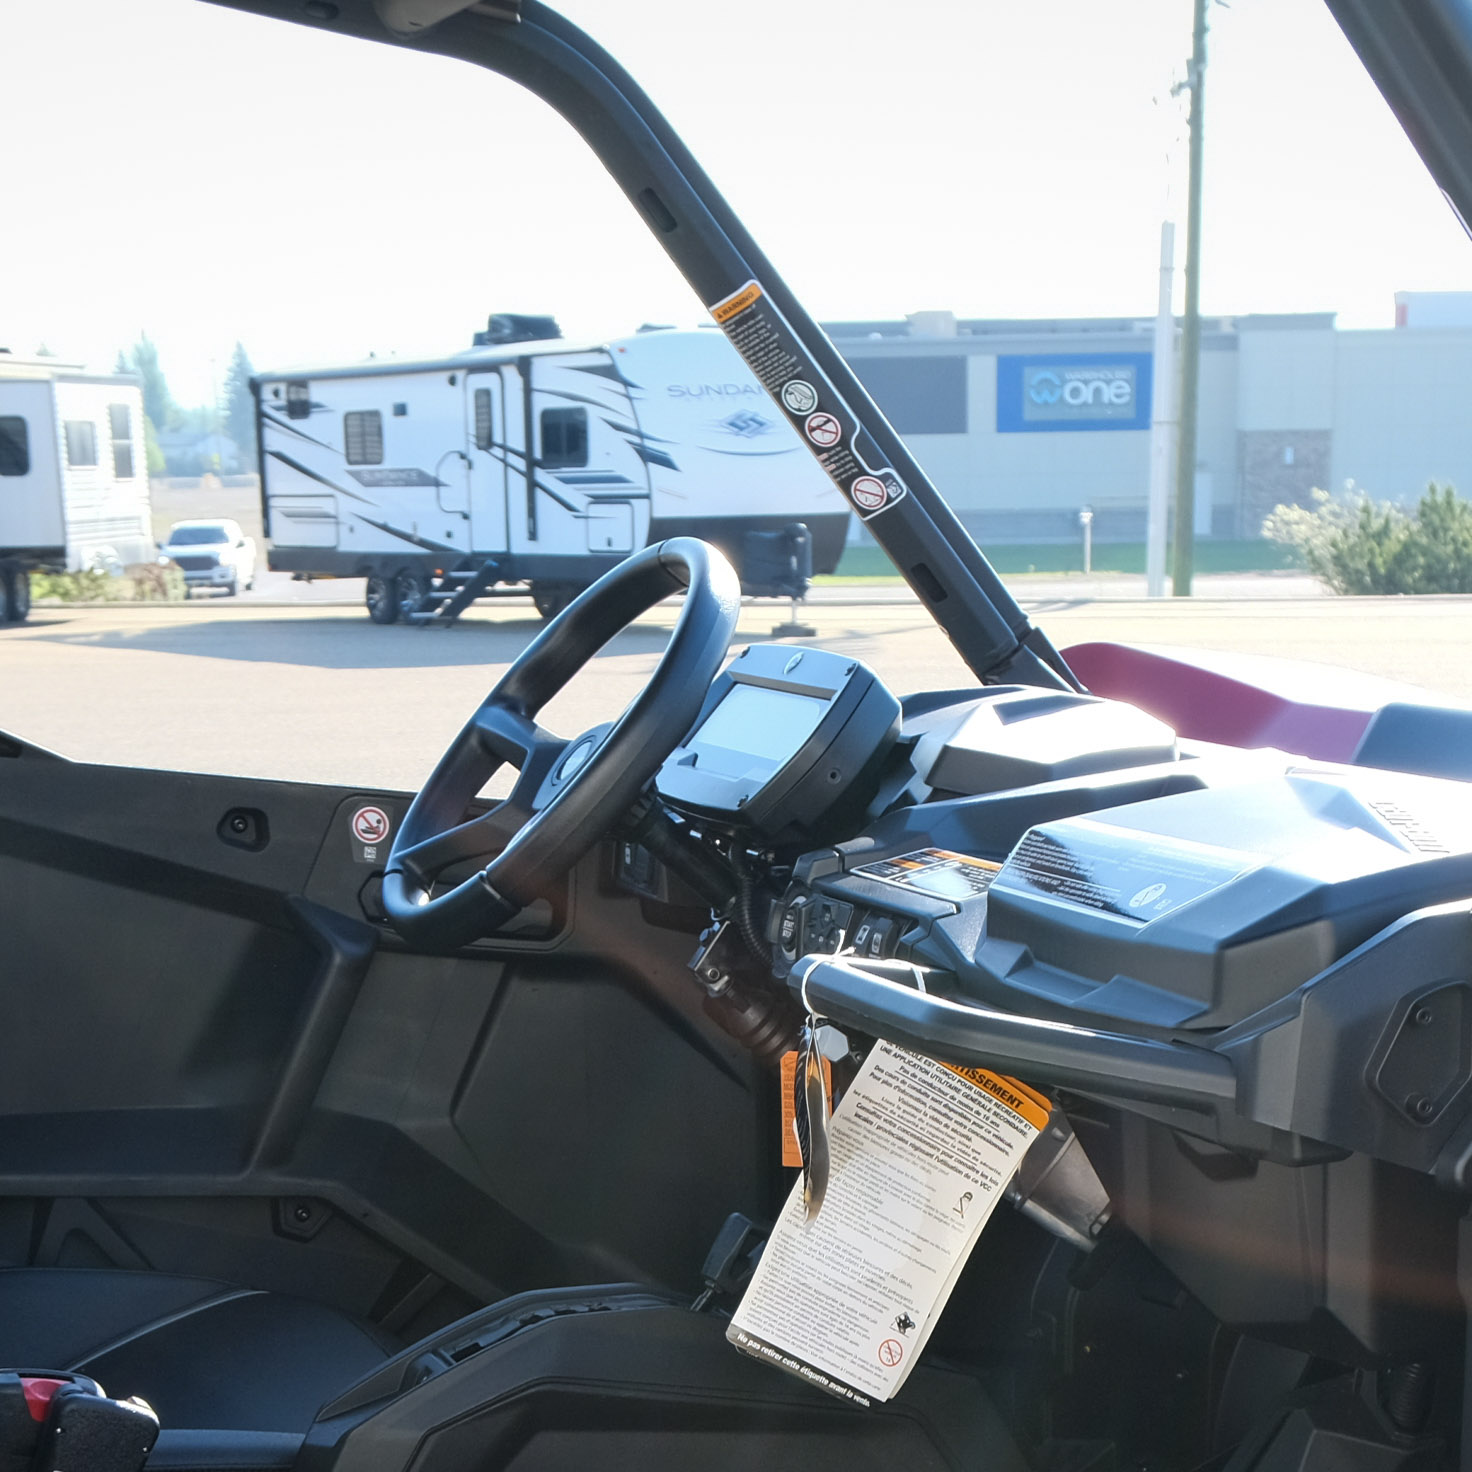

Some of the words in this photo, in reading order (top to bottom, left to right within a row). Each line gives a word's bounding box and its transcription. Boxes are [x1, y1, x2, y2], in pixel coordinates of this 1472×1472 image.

[721, 290, 755, 316] WARNING
[1063, 380, 1131, 405] one
[879, 1044, 893, 1055] UNE
[891, 1051, 930, 1076] APPLICATION
[929, 1071, 962, 1094] UTILITAIRE
[960, 1090, 993, 1113] GÉNÉRALE
[991, 1109, 1029, 1139] SECONDAIRE.
[898, 1064, 911, 1075] Pas
[909, 1070, 918, 1079] de
[917, 1075, 950, 1097] conducteur
[948, 1093, 957, 1102] de
[955, 1098, 975, 1112] moins
[973, 1108, 982, 1117] de
[981, 1113, 991, 1122] 16
[988, 1118, 1001, 1128] ans
[922, 1058, 935, 1070] EST
[934, 1065, 957, 1082] CONÇU
[955, 1077, 974, 1092] POUR
[972, 1088, 994, 1105] USAGE
[992, 1100, 1025, 1125] RÉCRÉATIF
[1023, 1121, 1033, 1131] ET
[735, 1332, 749, 1344] Ne
[745, 1337, 762, 1352] pas
[759, 1344, 783, 1362] retirer
[780, 1355, 801, 1371] cette
[797, 1363, 830, 1388] étiquette
[827, 1379, 848, 1396] avant
[844, 1388, 855, 1399] la
[851, 1392, 872, 1408] vente.
